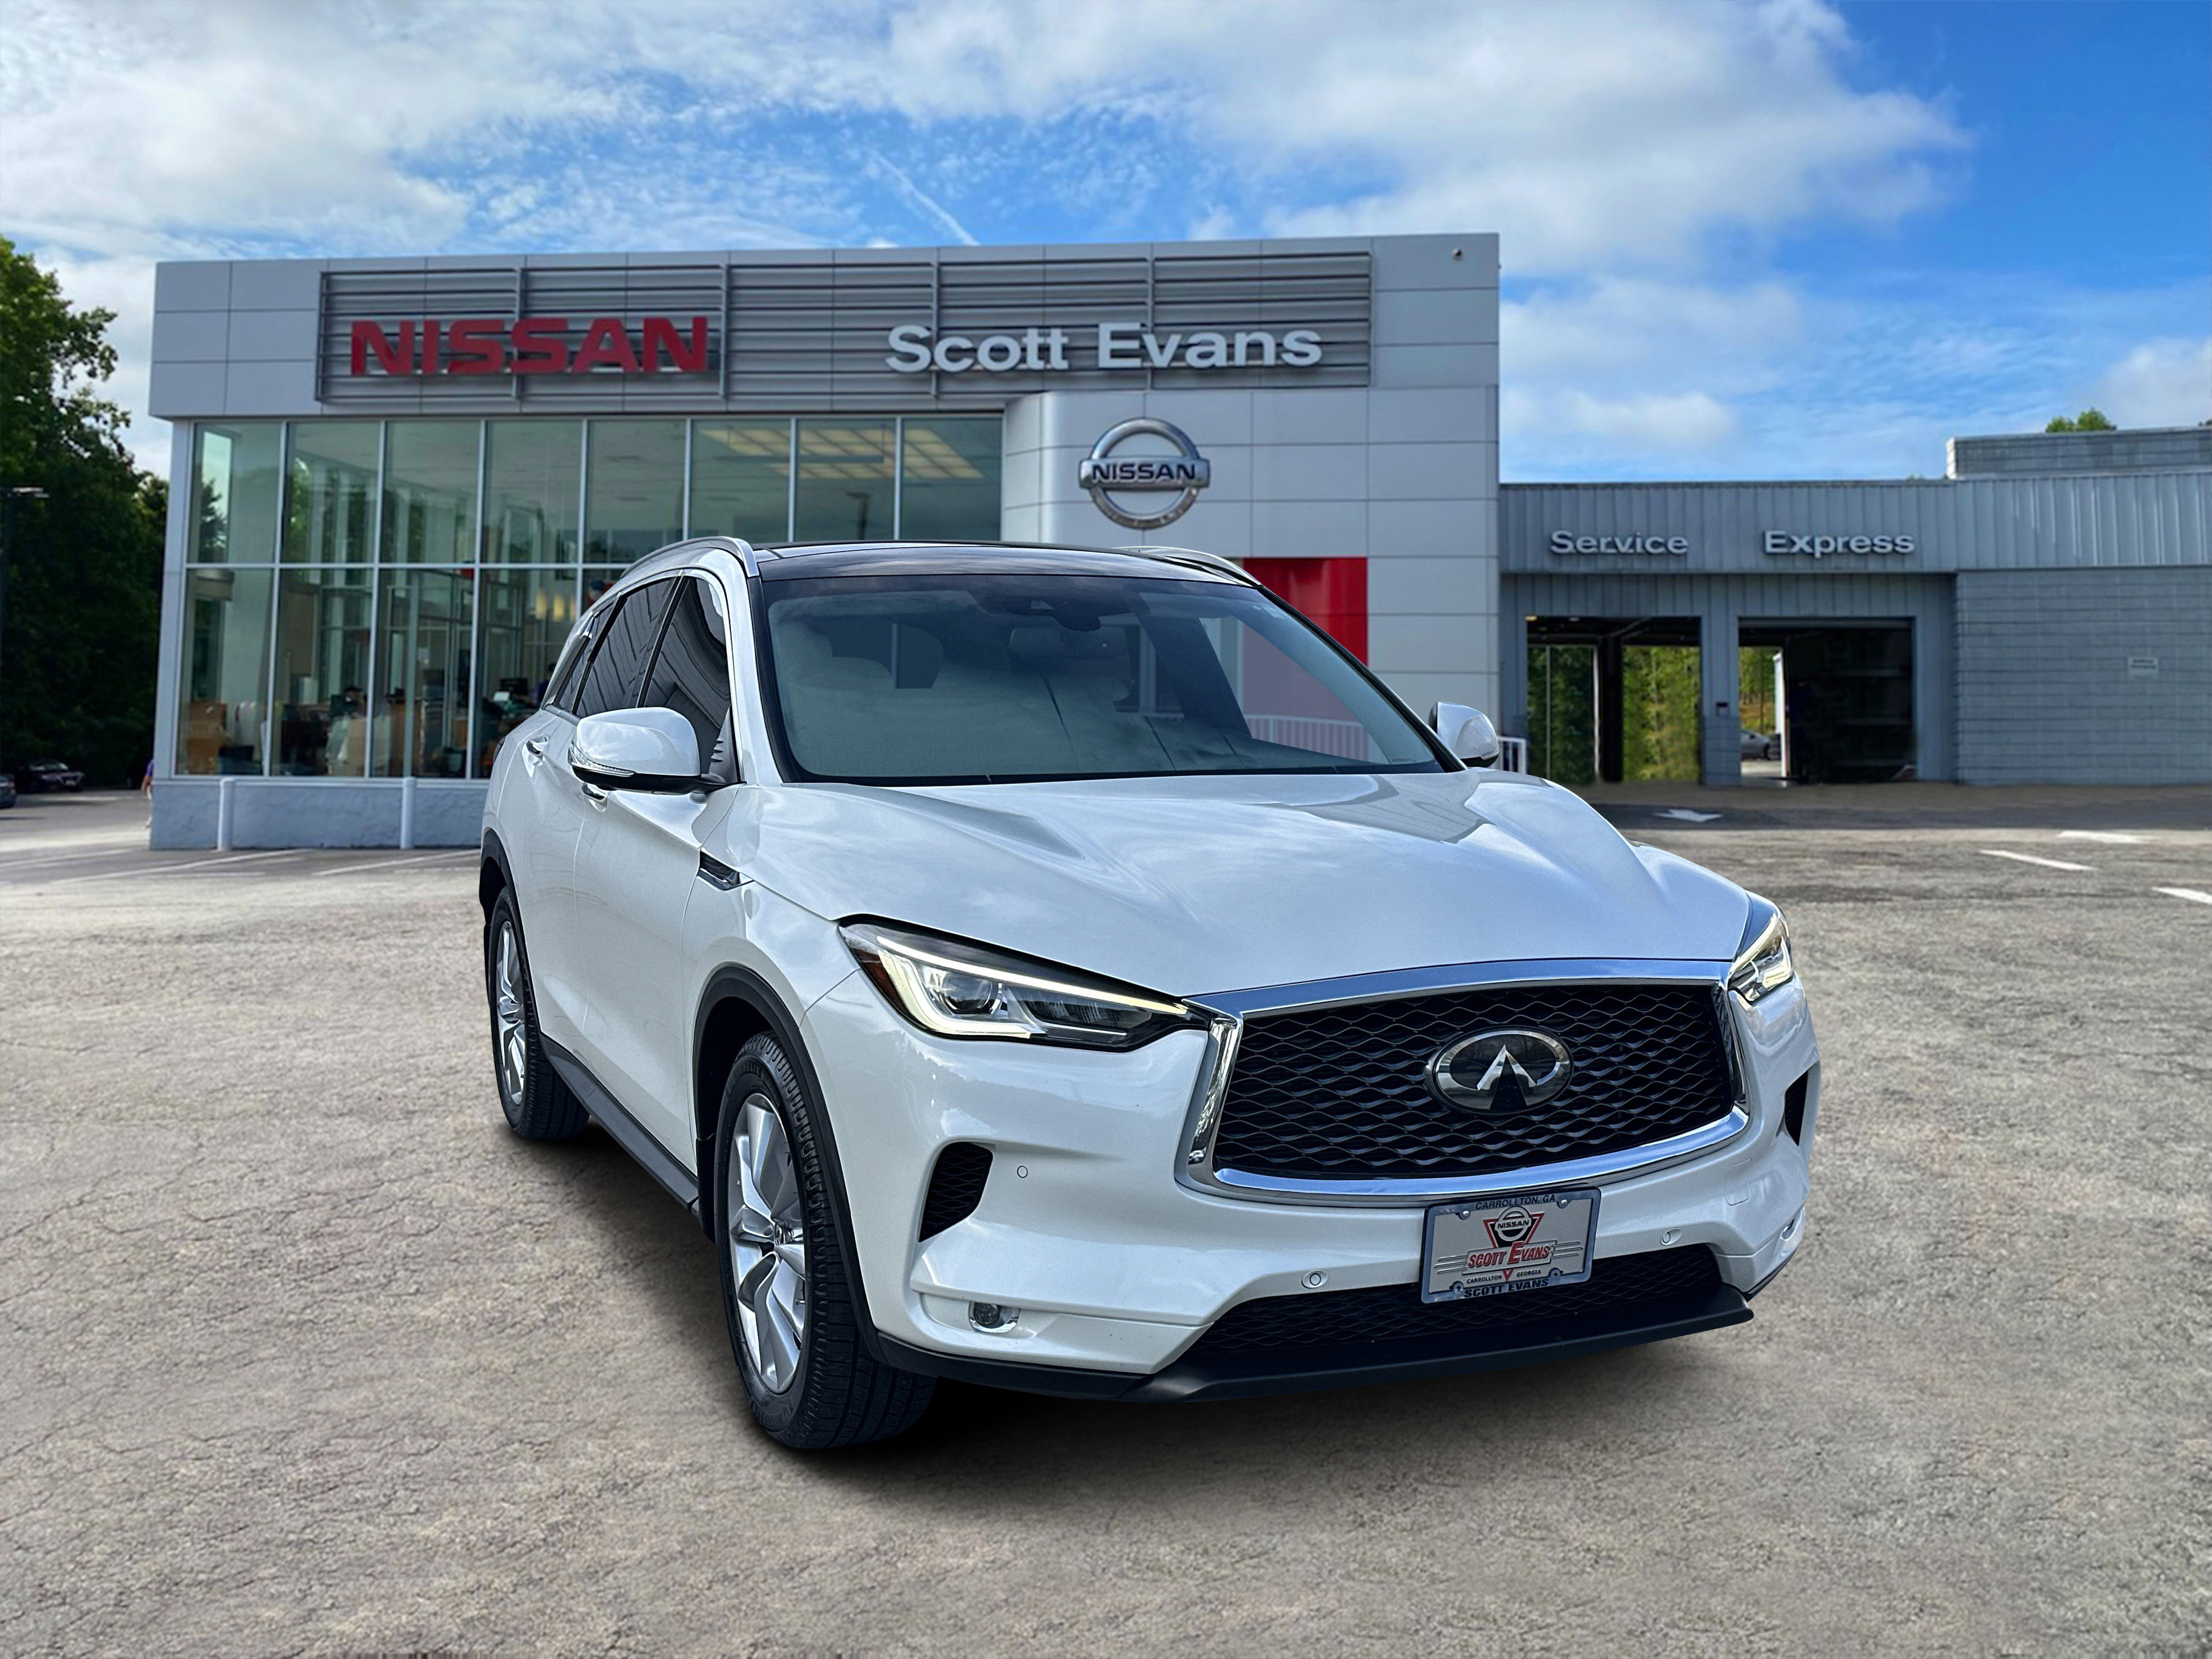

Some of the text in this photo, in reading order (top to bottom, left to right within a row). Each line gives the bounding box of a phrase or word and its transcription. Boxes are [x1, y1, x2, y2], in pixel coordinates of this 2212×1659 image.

[350, 317, 708, 376] NISSAN
[884, 321, 1323, 373] Scott Evans
[1092, 464, 1195, 480] NISSAN
[1549, 529, 1916, 559] Service Express
[1543, 1194, 1556, 1203] GA
[1497, 1220, 1529, 1228] NISSAN
[1468, 1251, 1508, 1268] SCOTT
[1466, 1269, 1541, 1284] CARROLLTON GEORGIA
[1464, 1279, 1549, 1298] SCOTT EVANS
